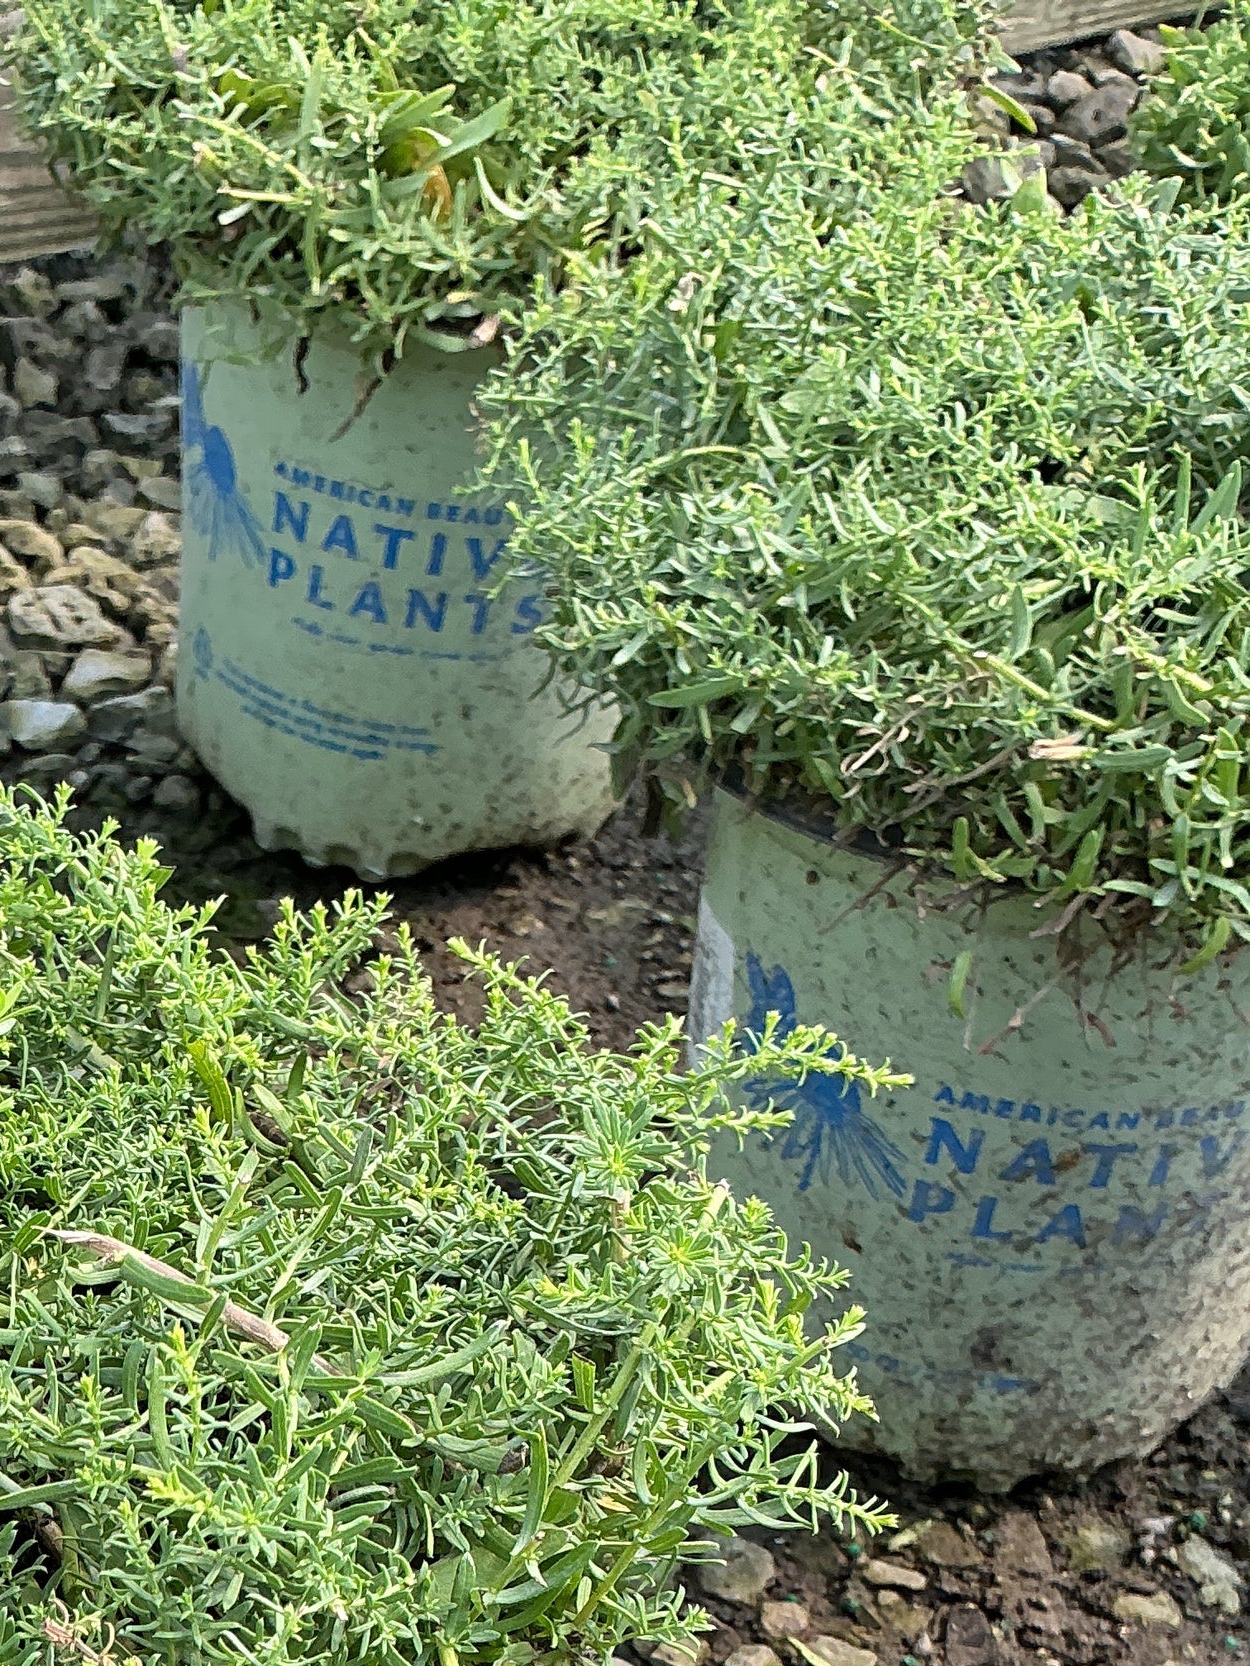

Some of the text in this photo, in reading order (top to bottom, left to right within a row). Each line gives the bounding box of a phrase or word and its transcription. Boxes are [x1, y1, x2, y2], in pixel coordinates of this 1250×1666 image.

[274, 461, 514, 527] AMERICAN BEAU
[272, 491, 514, 581] NATIV
[267, 548, 544, 635] PLANTS
[935, 1085, 1141, 1131] AMERICAN
